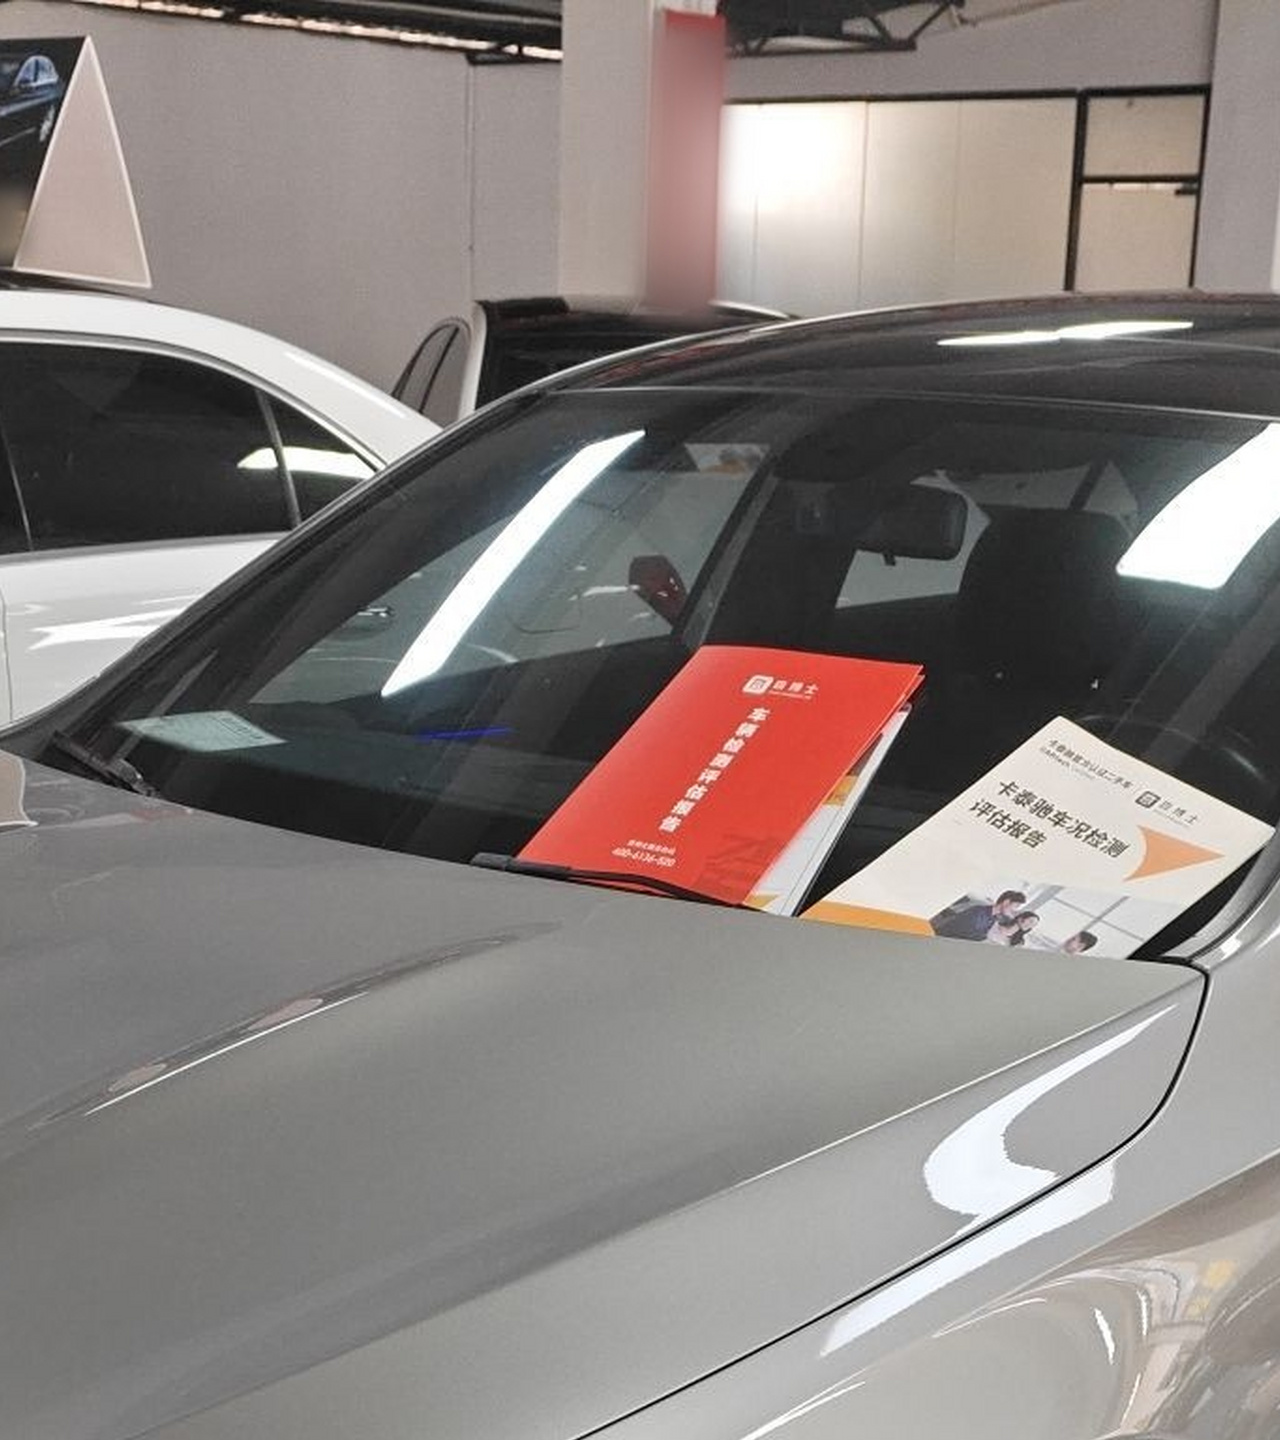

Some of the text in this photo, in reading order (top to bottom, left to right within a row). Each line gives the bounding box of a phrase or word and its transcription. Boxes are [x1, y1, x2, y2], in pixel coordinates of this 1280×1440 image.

[969, 798, 1048, 849] 评估报告
[997, 780, 1131, 859] 卡泰驰车况检测
